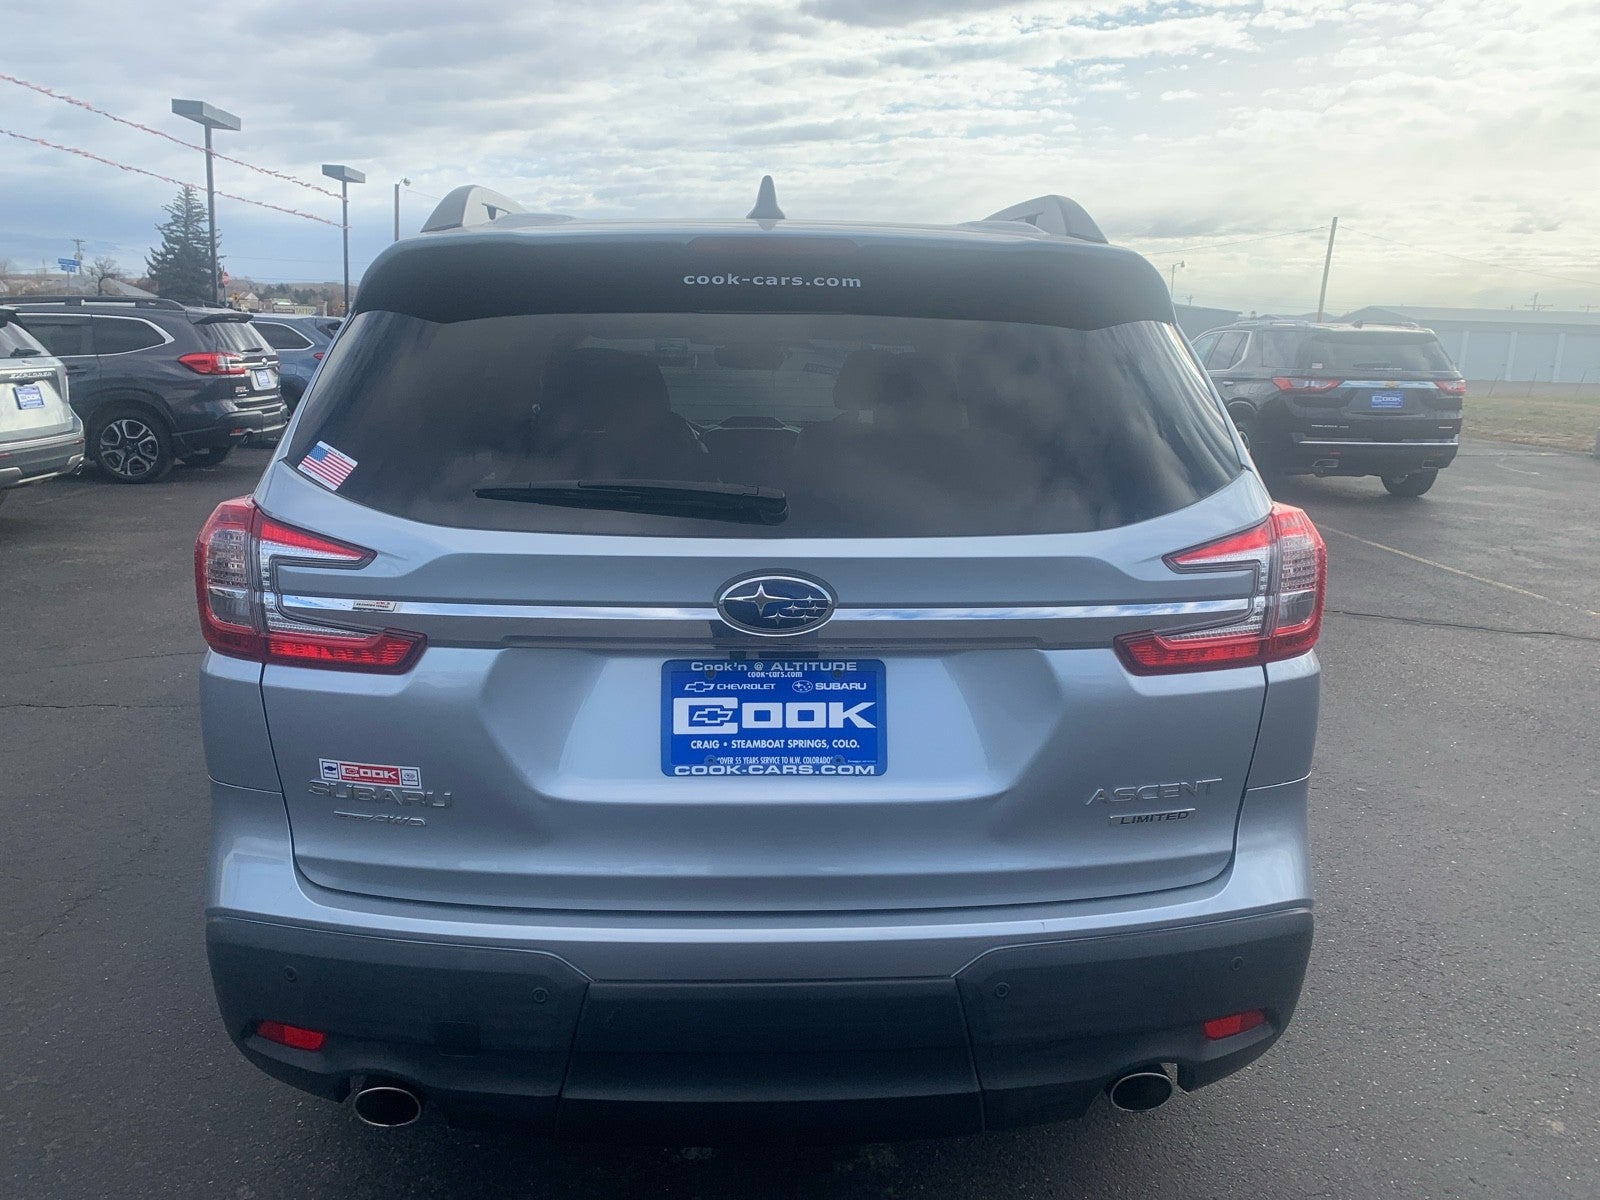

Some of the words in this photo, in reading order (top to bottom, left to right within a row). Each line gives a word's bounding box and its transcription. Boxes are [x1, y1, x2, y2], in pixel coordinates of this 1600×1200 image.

[683, 273, 862, 288] cook-cars.com
[754, 662, 764, 672] @
[770, 662, 857, 671] ALTITUDE
[815, 682, 867, 691] SUBARU
[673, 697, 877, 735] COOK
[690, 740, 720, 749] CRAIG
[731, 740, 785, 749] STEAMBOAT
[787, 740, 829, 750] SPRINGS,
[832, 740, 860, 749] COLO.
[743, 756, 759, 764] YEARS
[760, 756, 780, 764] SERVICE
[781, 756, 789, 764] TO
[340, 765, 399, 780] COOK
[674, 765, 875, 776] COOK-CARS.COM
[308, 780, 452, 807] SUBARU
[1085, 778, 1223, 806] ASCENT
[1120, 811, 1190, 825] LIMITED
